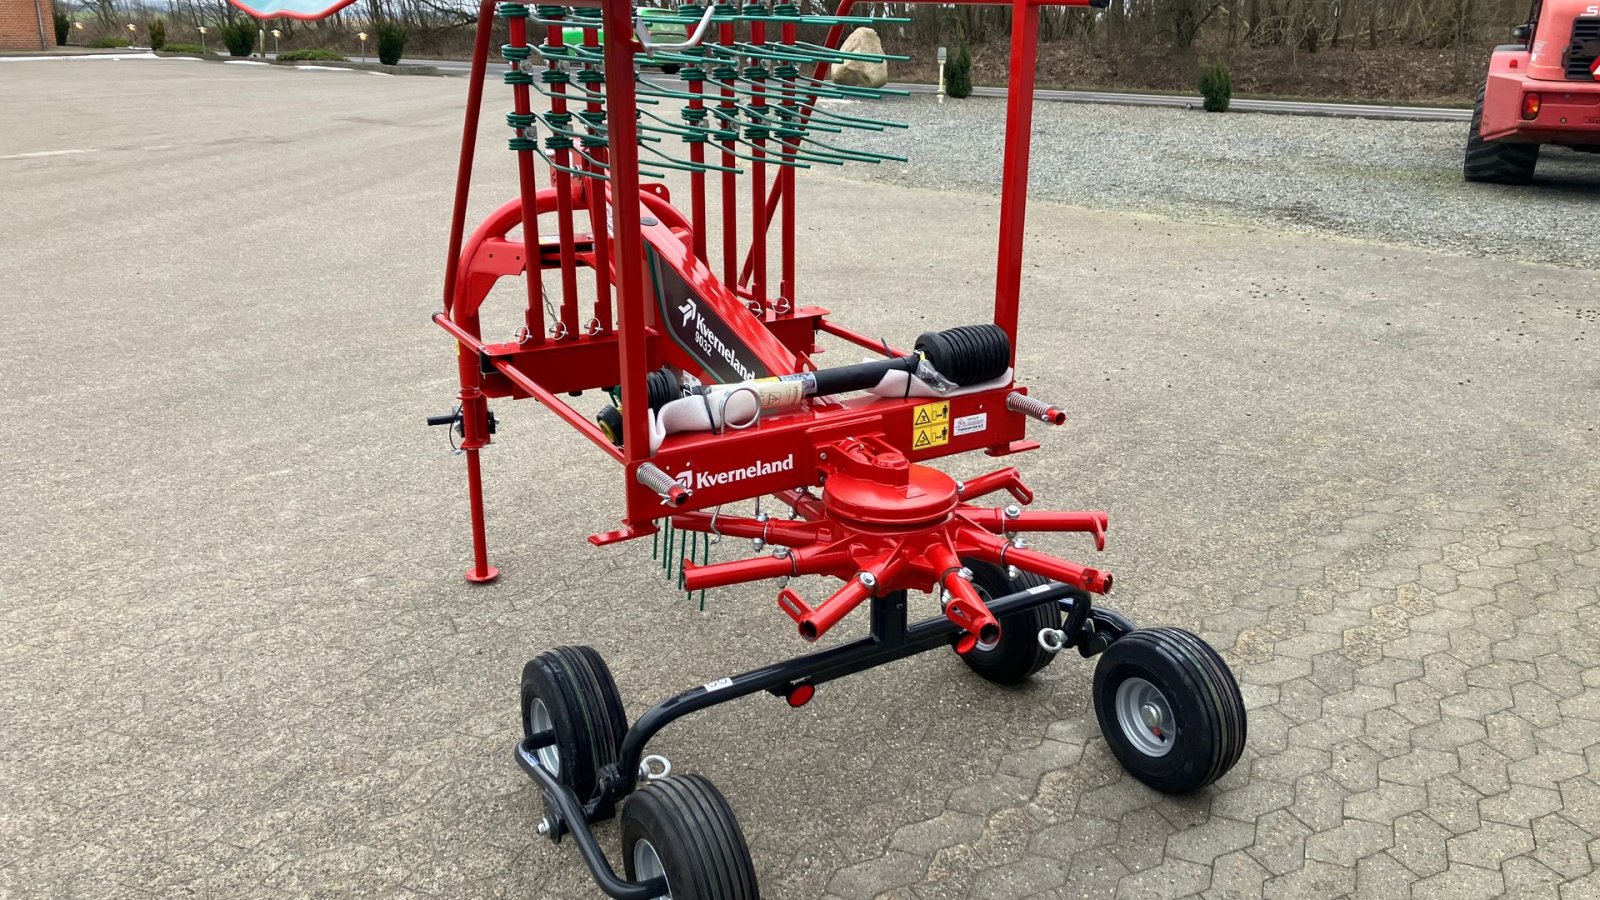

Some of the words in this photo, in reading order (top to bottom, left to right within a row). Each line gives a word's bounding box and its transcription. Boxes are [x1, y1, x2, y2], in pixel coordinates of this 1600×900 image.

[1580, 5, 1600, 16] S
[694, 331, 712, 357] 9032
[696, 312, 756, 381] Kverneland
[696, 453, 794, 489] Kverneland
